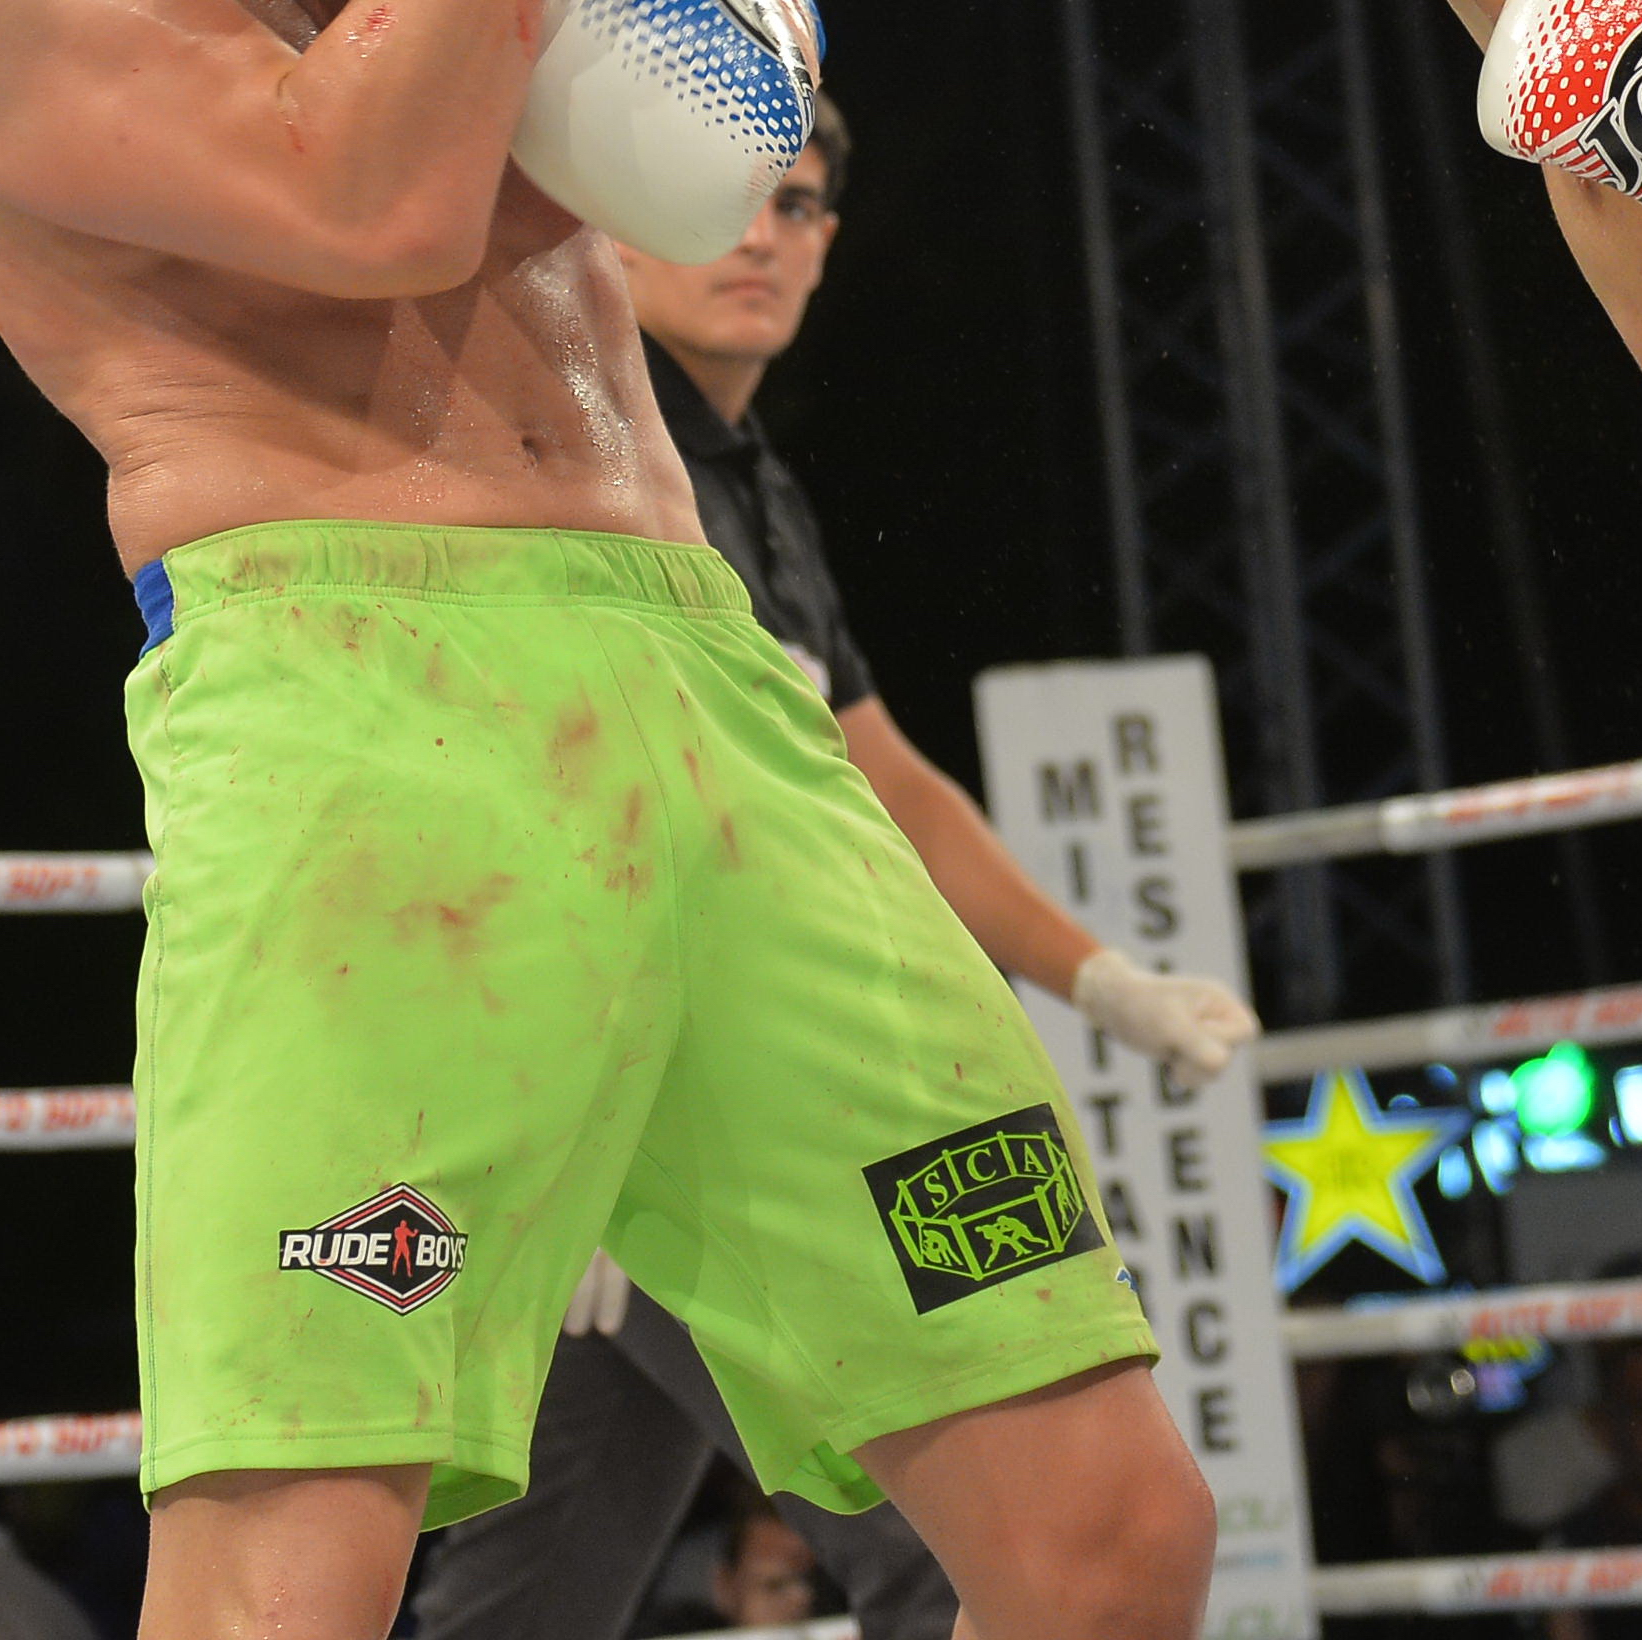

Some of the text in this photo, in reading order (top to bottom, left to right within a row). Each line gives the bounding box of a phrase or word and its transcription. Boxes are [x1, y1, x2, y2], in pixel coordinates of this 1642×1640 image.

[922, 1141, 1048, 1210] SCA
[281, 1233, 466, 1269] RUDE BOYS
